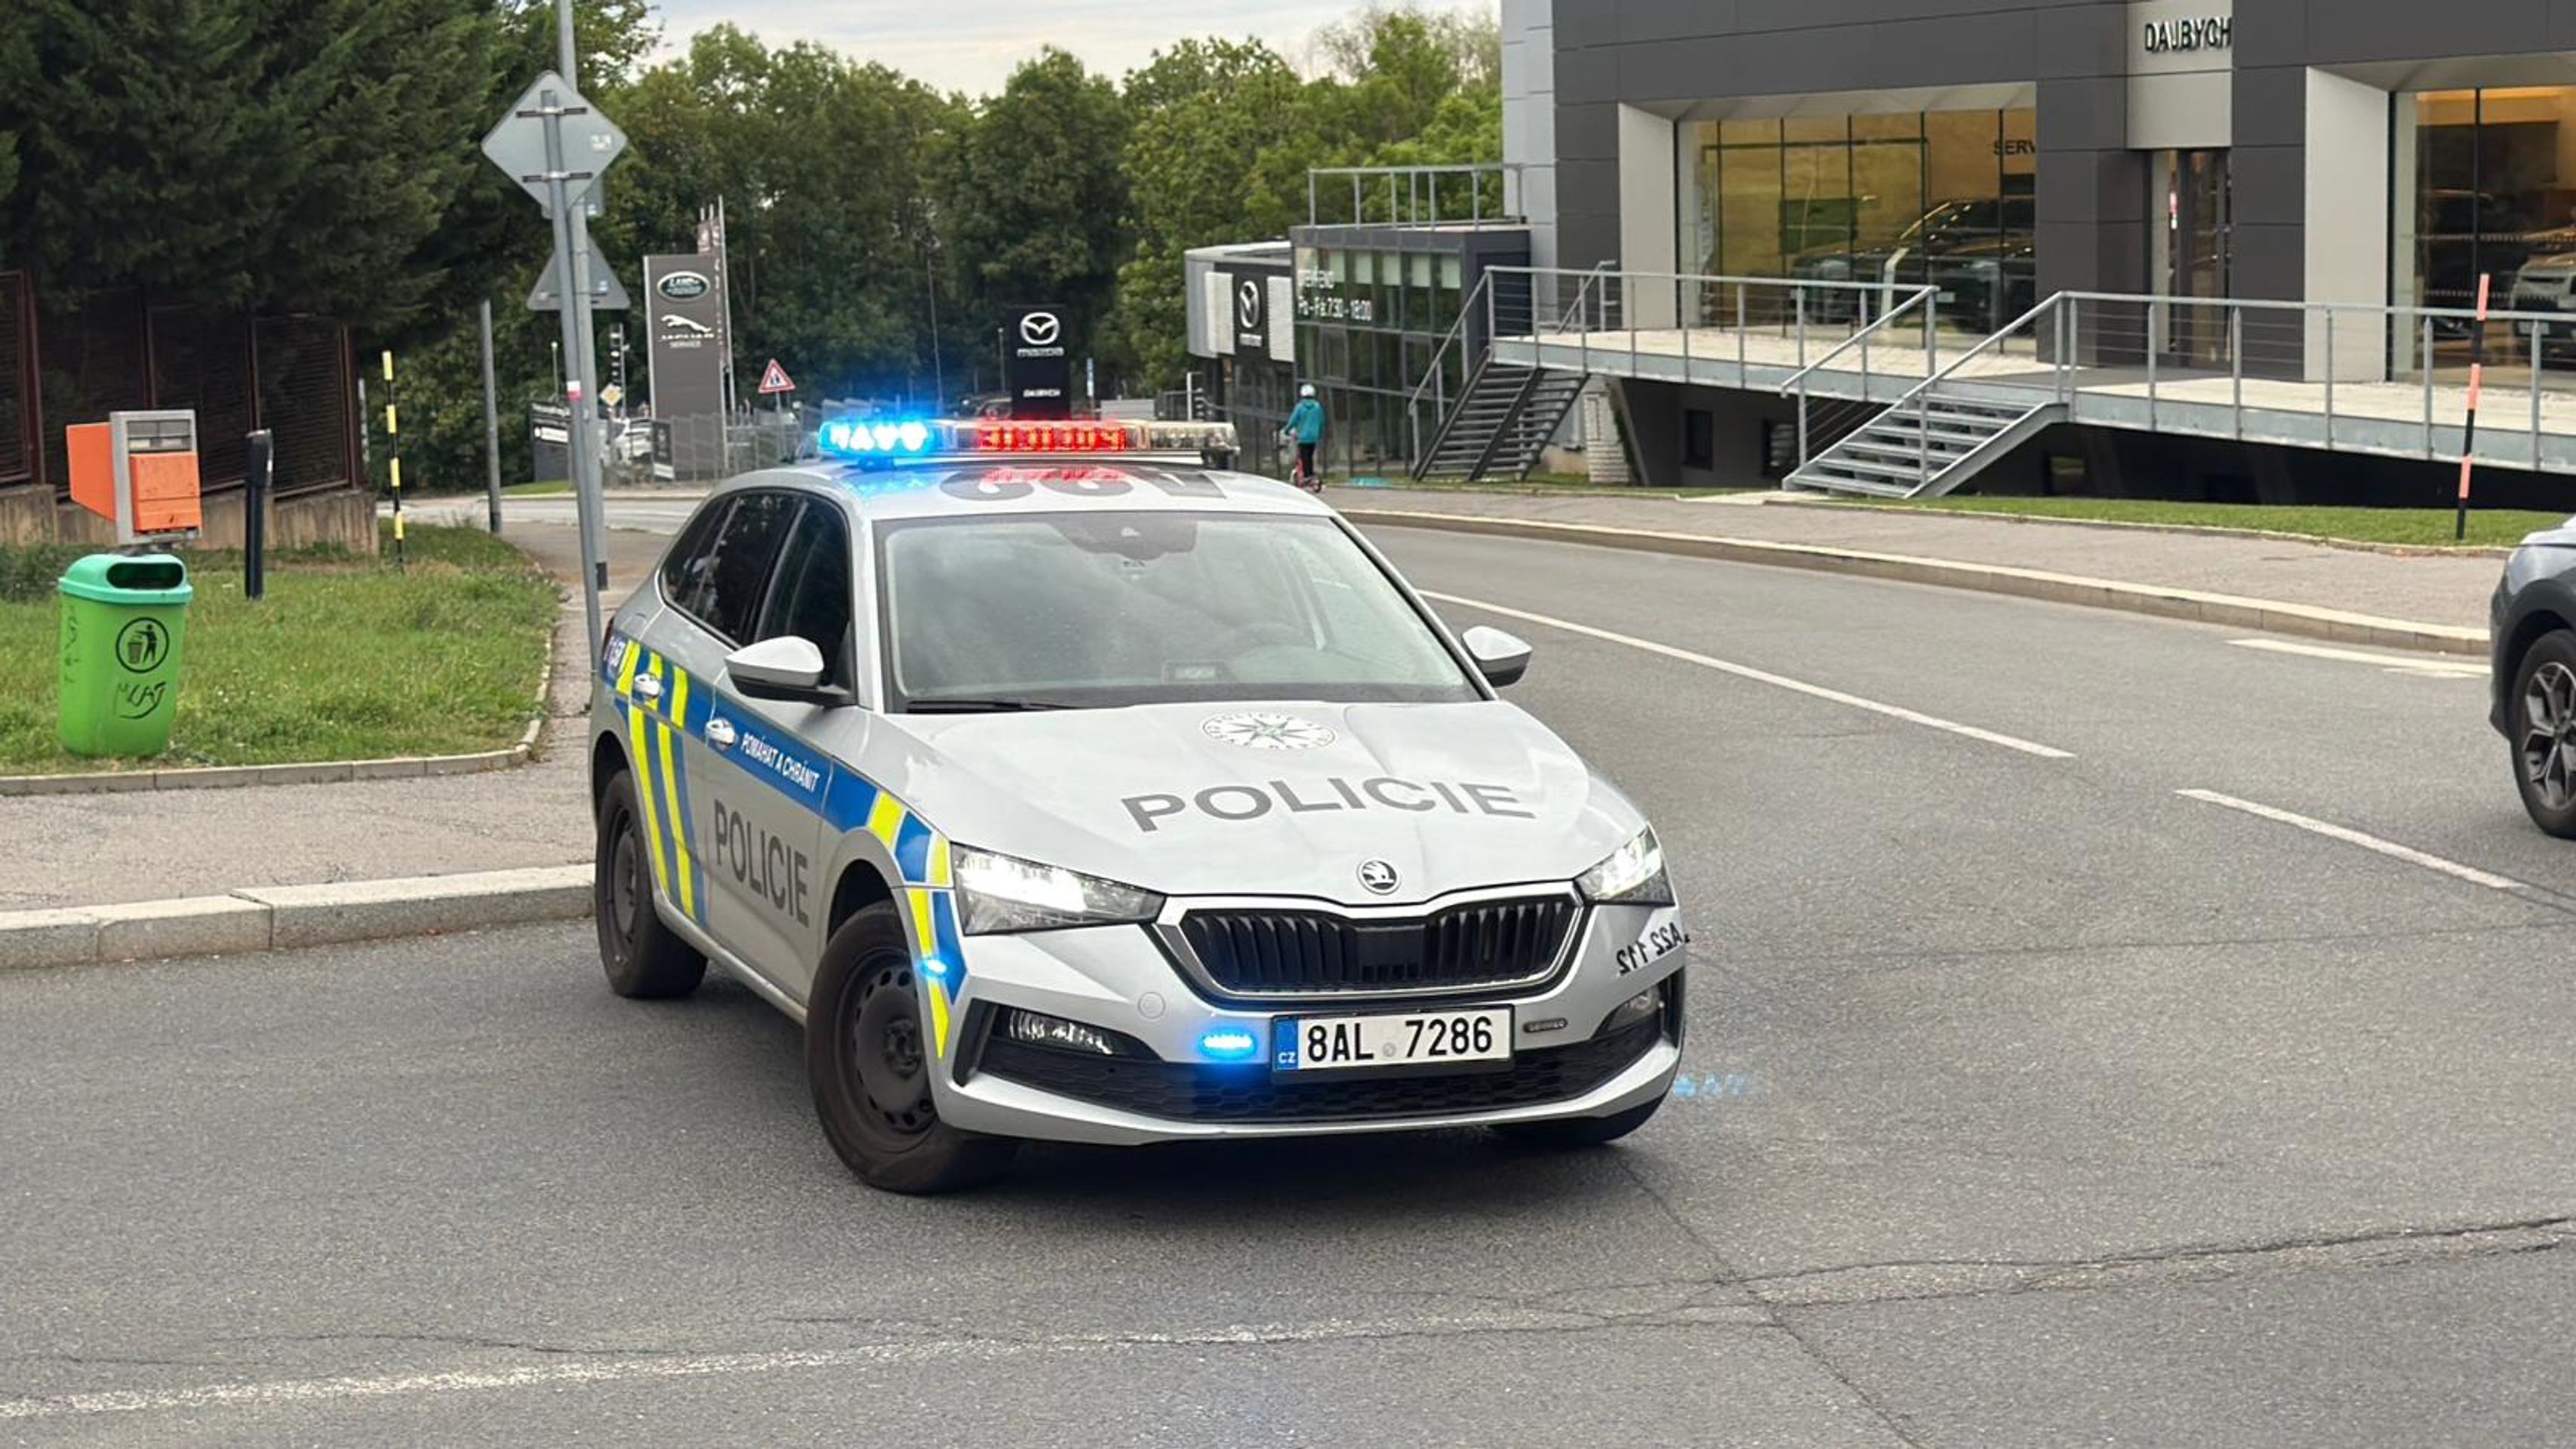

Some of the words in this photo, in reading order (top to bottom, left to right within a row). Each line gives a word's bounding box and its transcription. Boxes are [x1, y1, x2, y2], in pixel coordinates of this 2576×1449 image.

[2144, 17, 2232, 52] DAJBYCH
[774, 752, 783, 773] A
[1122, 777, 1535, 832] POLICIE
[714, 799, 810, 928] POLICIE
[1278, 1052, 1296, 1064] CZ
[1307, 1023, 1374, 1062] 8AL
[1405, 1017, 1492, 1058] 7286
